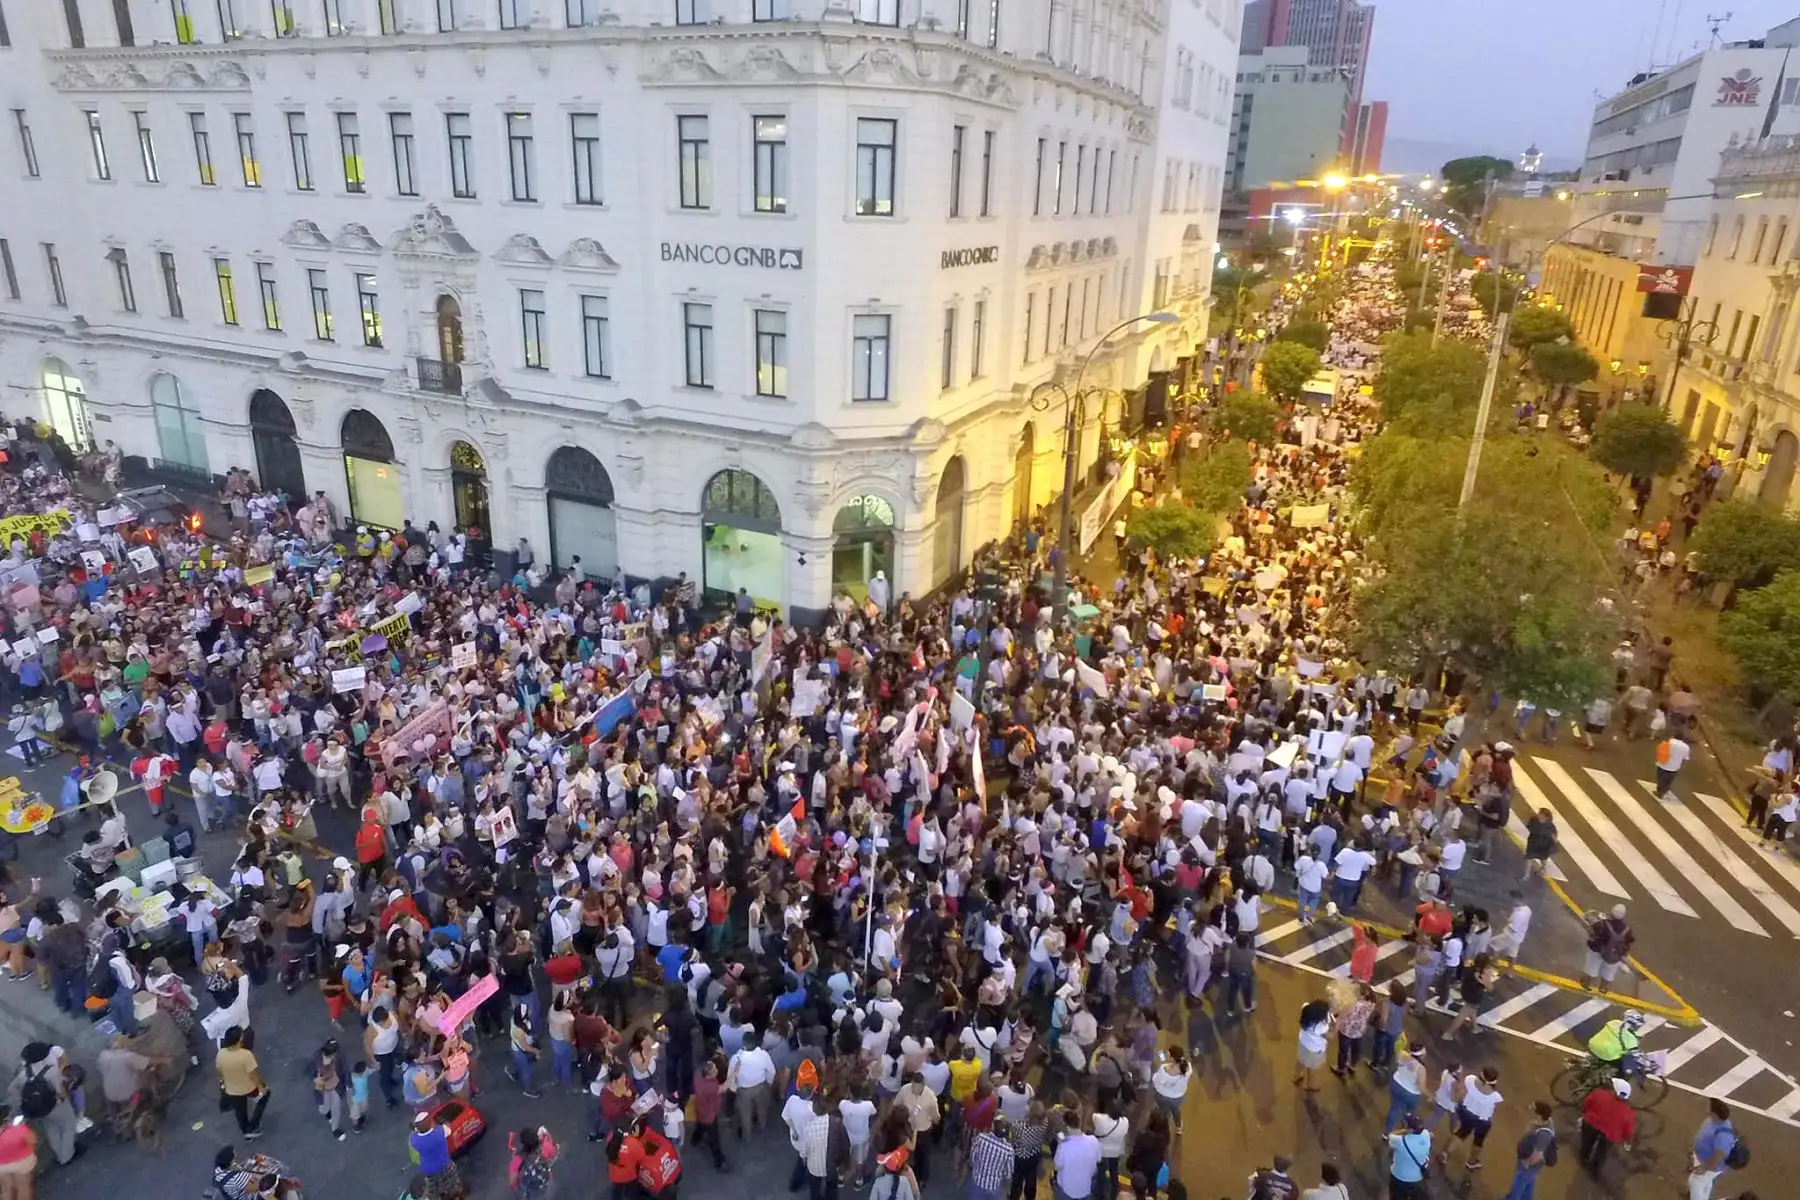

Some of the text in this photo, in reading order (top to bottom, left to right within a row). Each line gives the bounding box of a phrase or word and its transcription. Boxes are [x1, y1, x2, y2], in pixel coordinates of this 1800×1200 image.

[1715, 92, 1759, 104] JNE
[660, 241, 777, 269] BANCO GNB
[941, 248, 973, 270] BANCO
